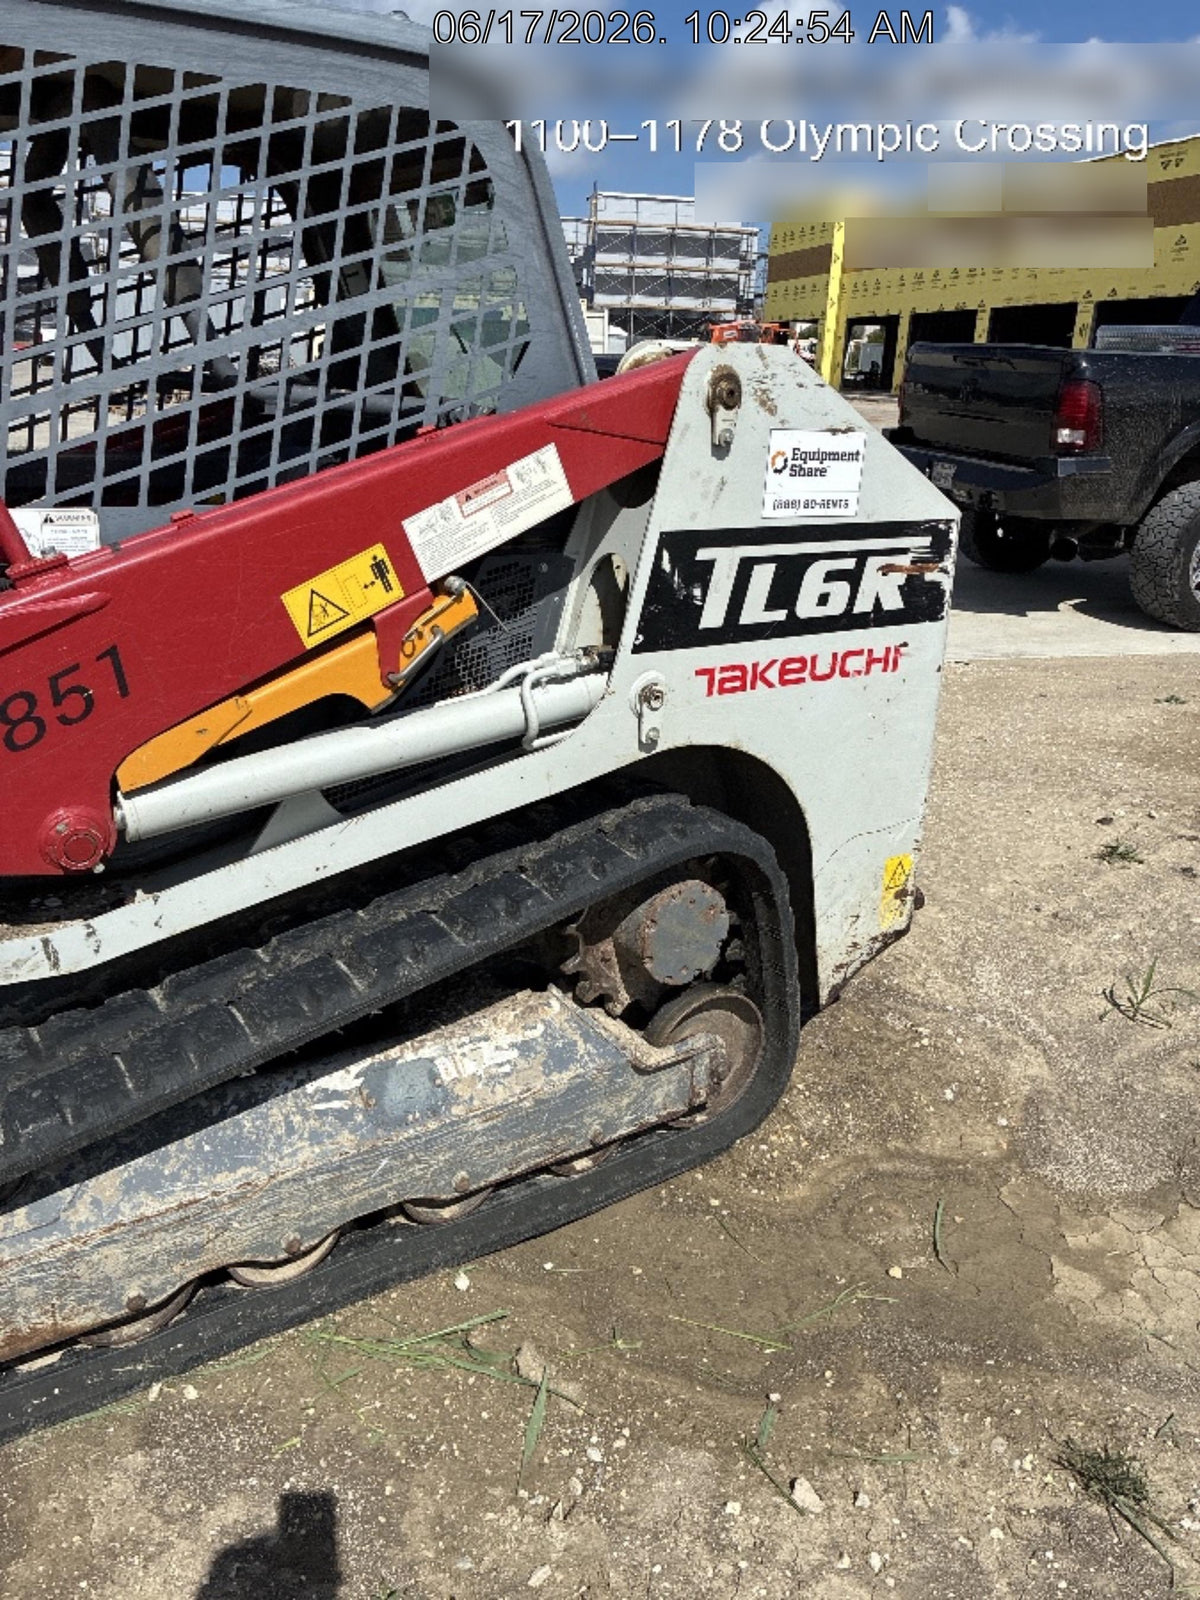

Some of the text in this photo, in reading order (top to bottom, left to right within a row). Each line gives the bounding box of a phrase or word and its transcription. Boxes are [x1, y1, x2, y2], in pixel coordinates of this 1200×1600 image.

[788, 464, 828, 478] Share
[790, 448, 861, 465] Equipment
[695, 536, 933, 631] TL6R
[0, 644, 130, 753] 851
